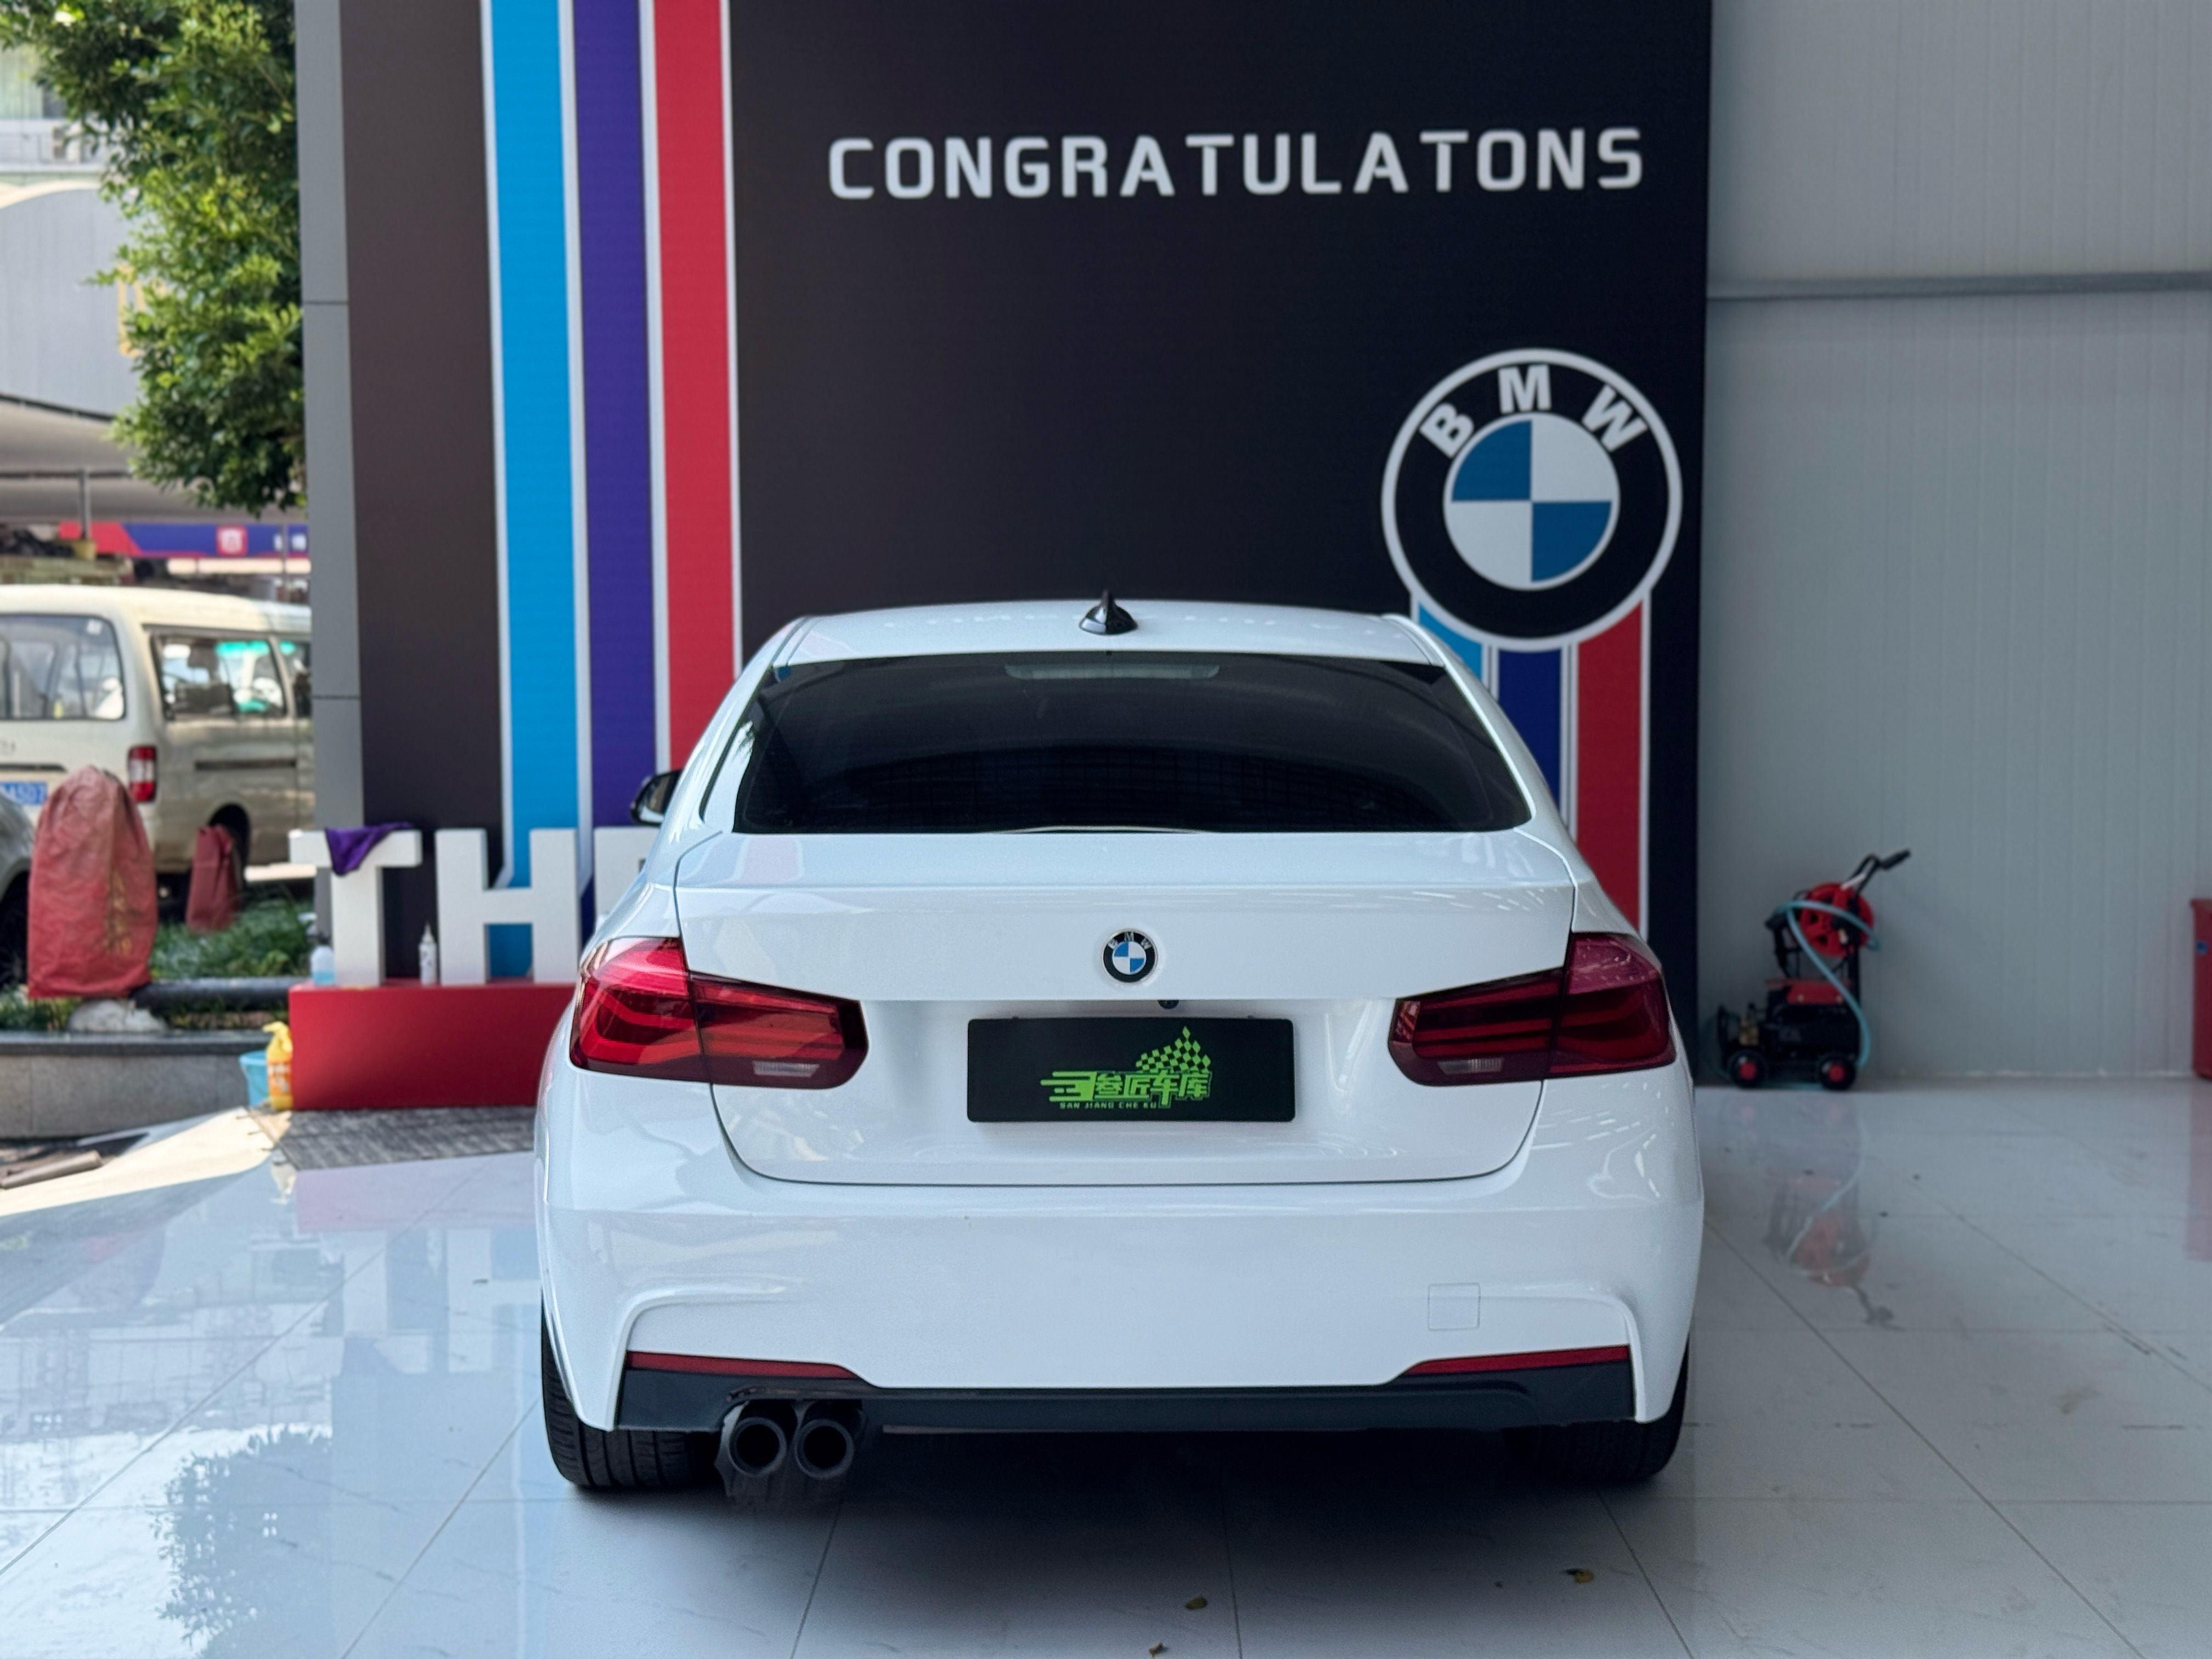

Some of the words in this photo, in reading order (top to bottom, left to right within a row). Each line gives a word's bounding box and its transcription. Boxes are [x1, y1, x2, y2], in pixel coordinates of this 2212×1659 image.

[828, 126, 1644, 200] CONGRATULATONS
[1419, 364, 1647, 459] BMW
[1108, 932, 1153, 950] BMW
